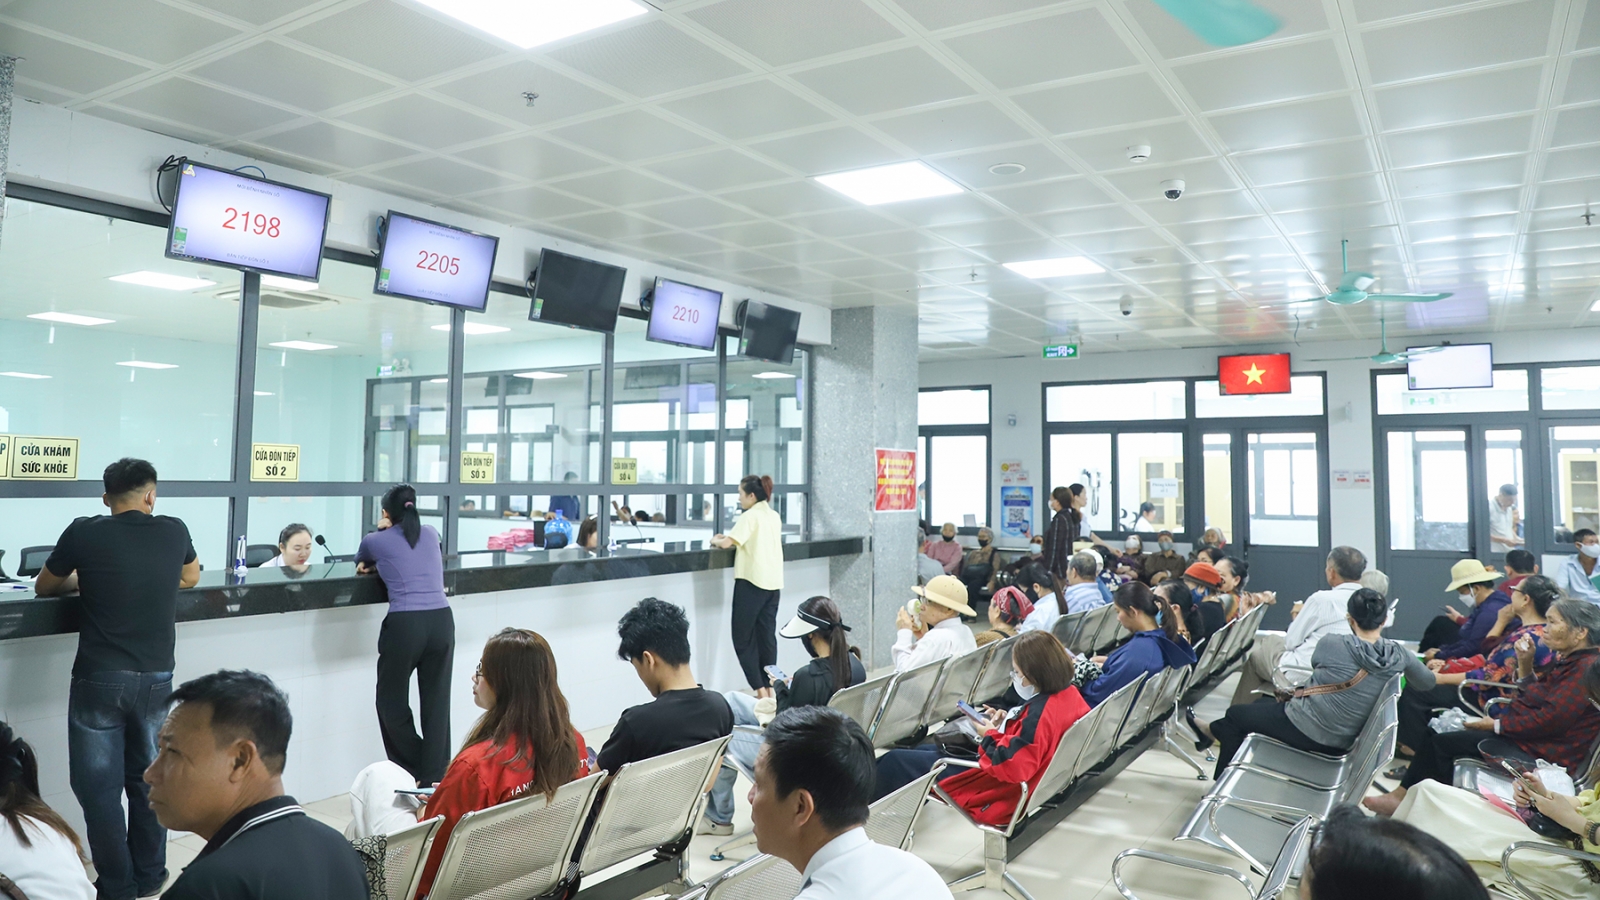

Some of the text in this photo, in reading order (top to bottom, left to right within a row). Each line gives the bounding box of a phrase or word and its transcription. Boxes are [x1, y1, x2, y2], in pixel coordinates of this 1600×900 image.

[222, 207, 281, 238] 2198
[416, 250, 461, 276] 2205
[672, 305, 699, 324] 2210
[21, 442, 71, 457] CỬA KHÁM
[255, 447, 296, 461] CỬA ĐÓN TIẾP
[21, 460, 68, 474] SỨC KHỎE
[463, 454, 492, 466] CỬA ĐÓN TIẾP
[265, 462, 287, 476] SỐ 2
[470, 467, 486, 479] SỐ 3
[619, 471, 626, 480] SỐ
